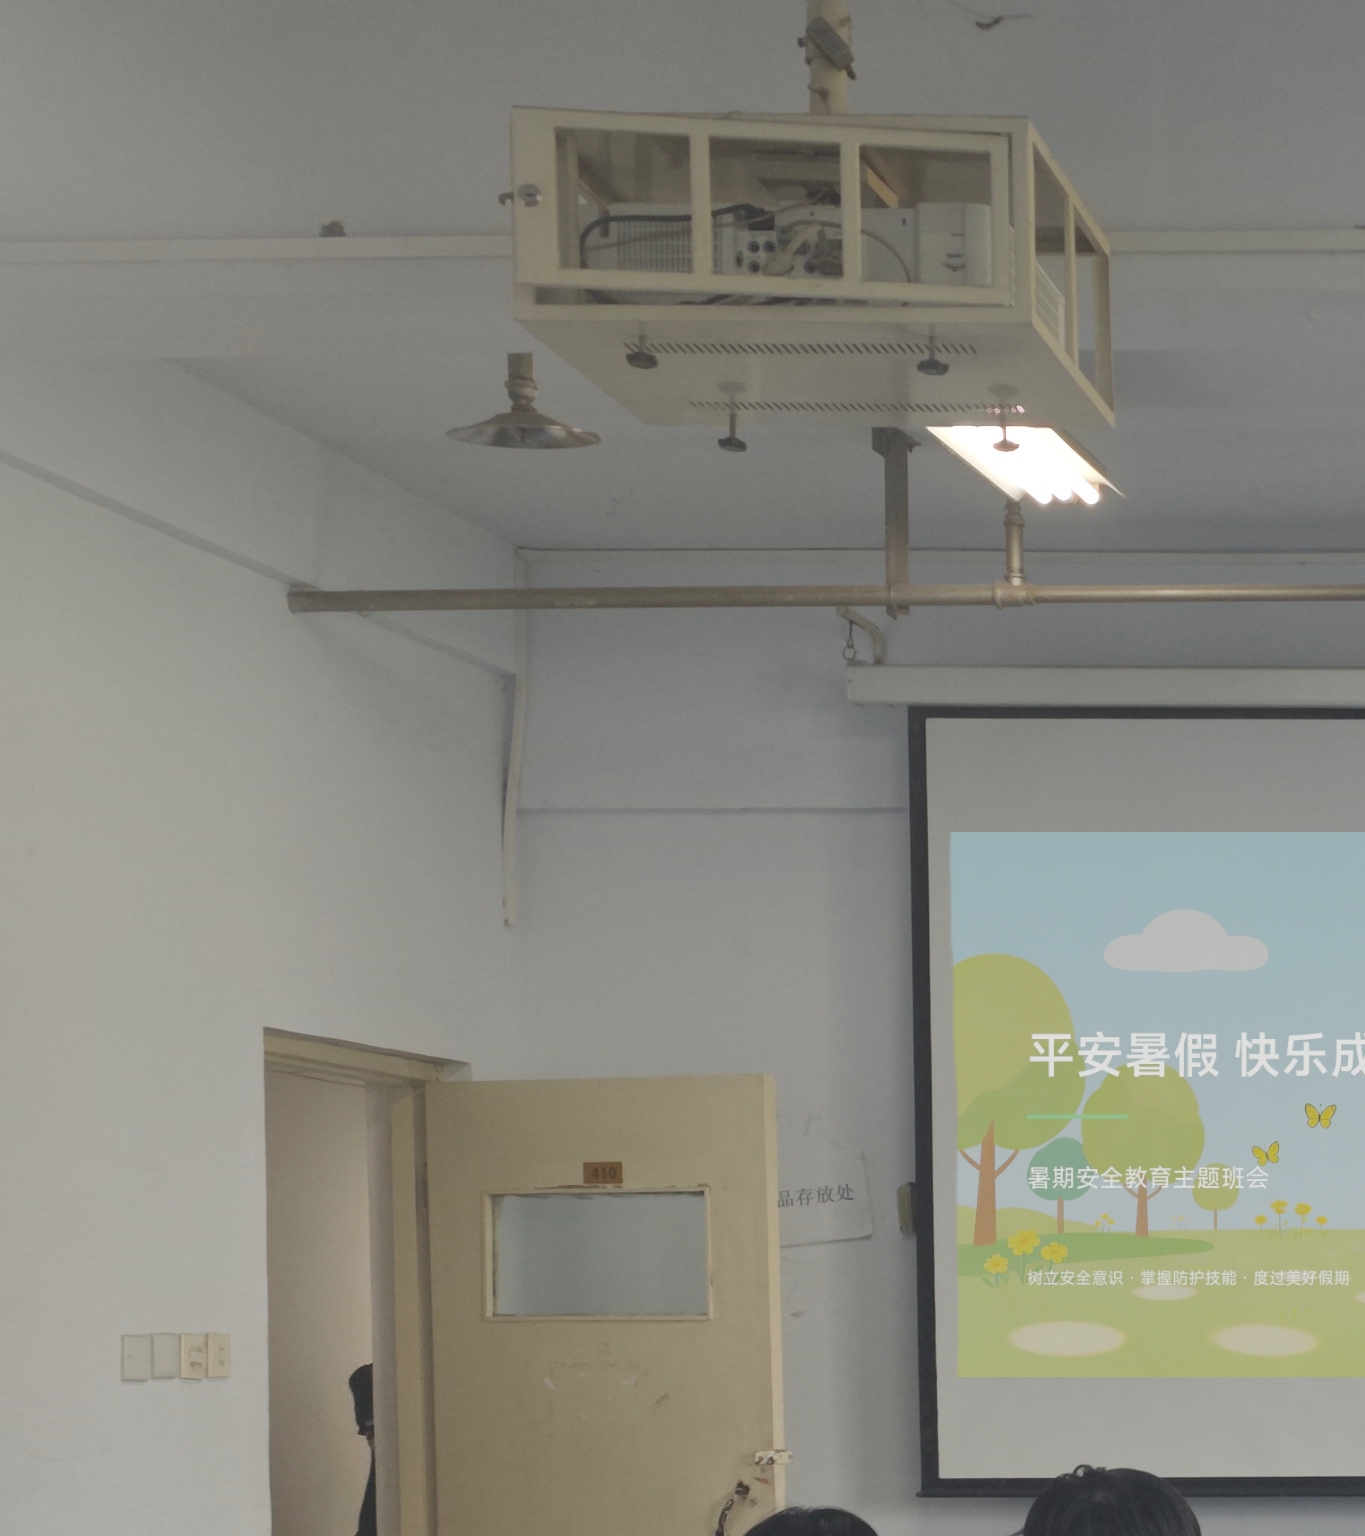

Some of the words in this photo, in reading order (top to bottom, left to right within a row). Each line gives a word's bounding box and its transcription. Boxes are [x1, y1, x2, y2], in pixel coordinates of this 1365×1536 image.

[1028, 1031, 1220, 1078] 平安暑假
[591, 1166, 618, 1180] 410
[1027, 1165, 1270, 1190] 暑期安全教育主题班会
[778, 1183, 855, 1209] 品存放处
[1027, 1269, 1124, 1287] 树立安全意识
[1140, 1269, 1238, 1287] 掌握防护技能
[1253, 1269, 1350, 1287] 度过美好假期
